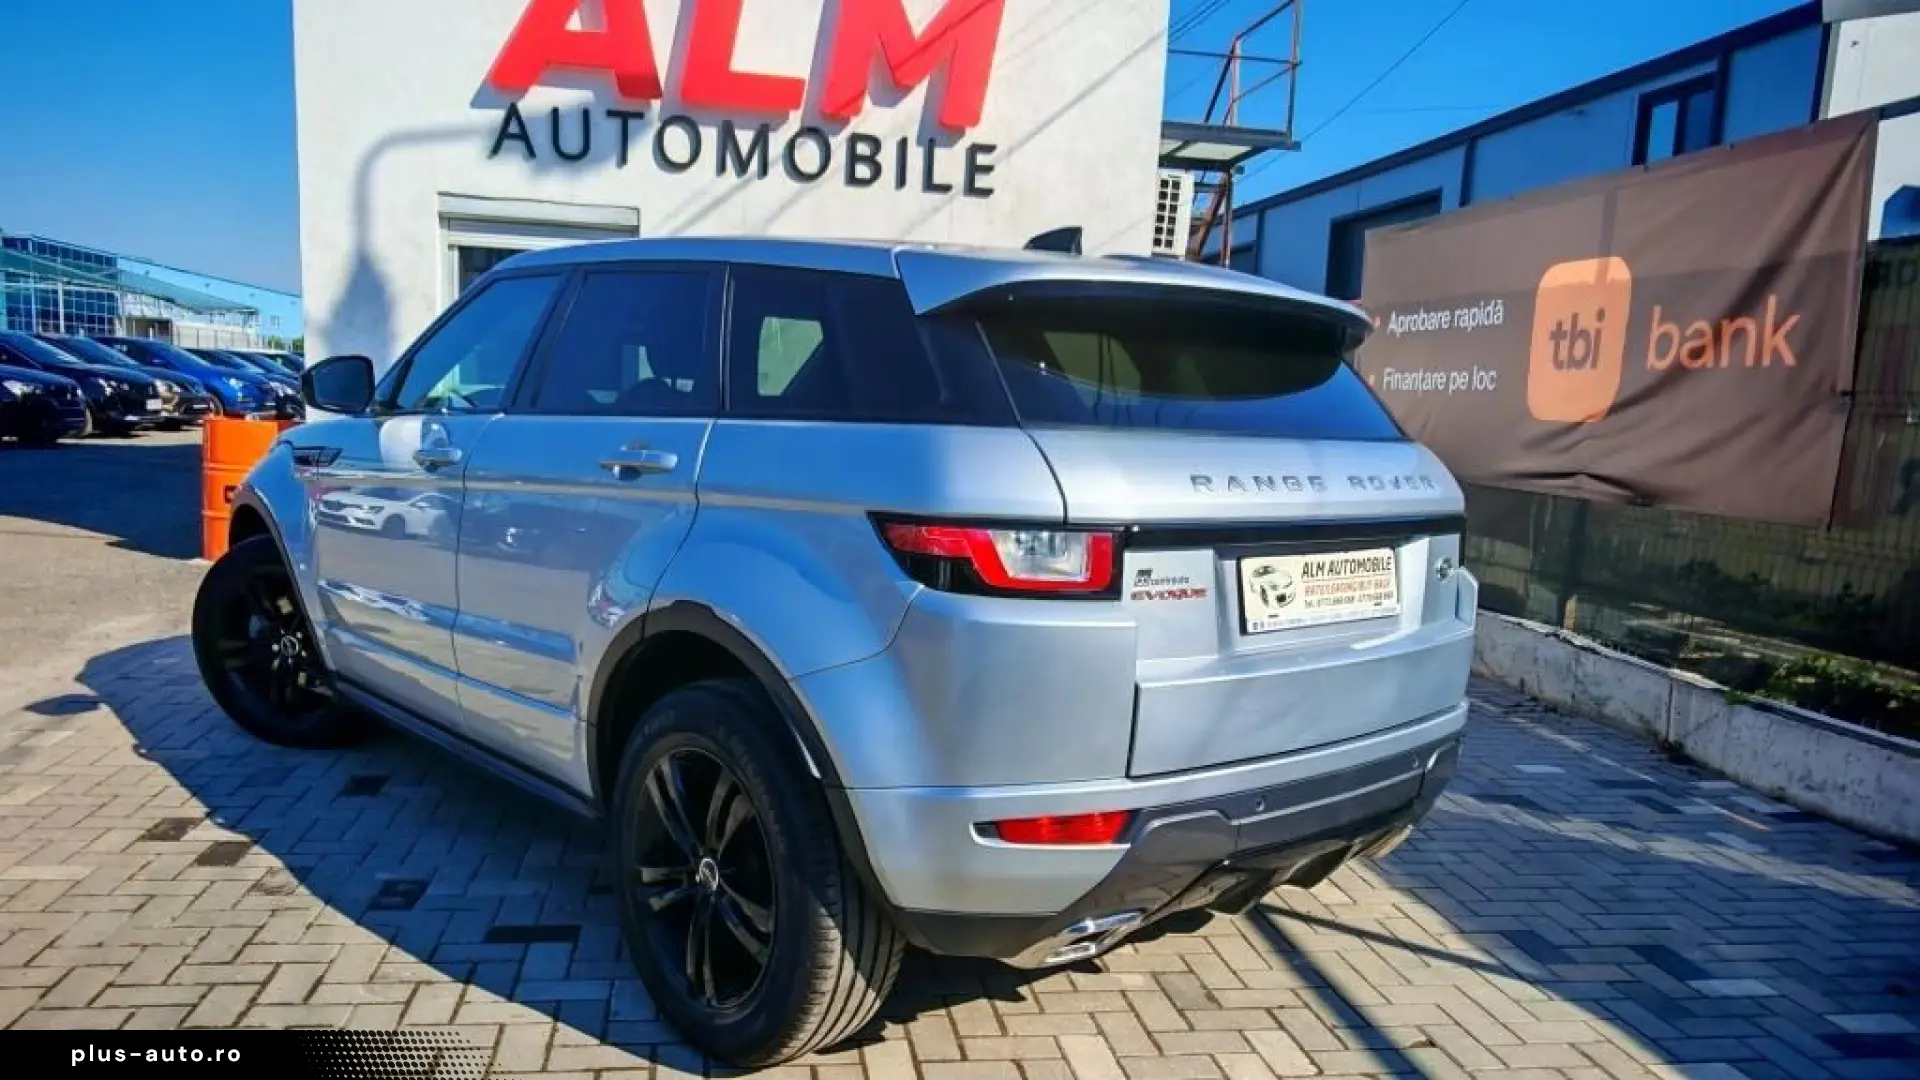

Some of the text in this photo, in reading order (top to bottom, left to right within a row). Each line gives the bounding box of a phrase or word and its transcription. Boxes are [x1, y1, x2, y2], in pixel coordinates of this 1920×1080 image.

[488, 0, 1005, 128] ALM
[488, 102, 998, 198] AUTOMOBILE
[1387, 299, 1504, 338] Aprobare rapidă
[1549, 295, 1802, 371] tbi bank
[1449, 369, 1469, 396] pe
[1472, 364, 1497, 391] loc
[1190, 474, 1436, 493] RANGE ROVER
[1301, 556, 1392, 579] ALM AUTOMOBILE
